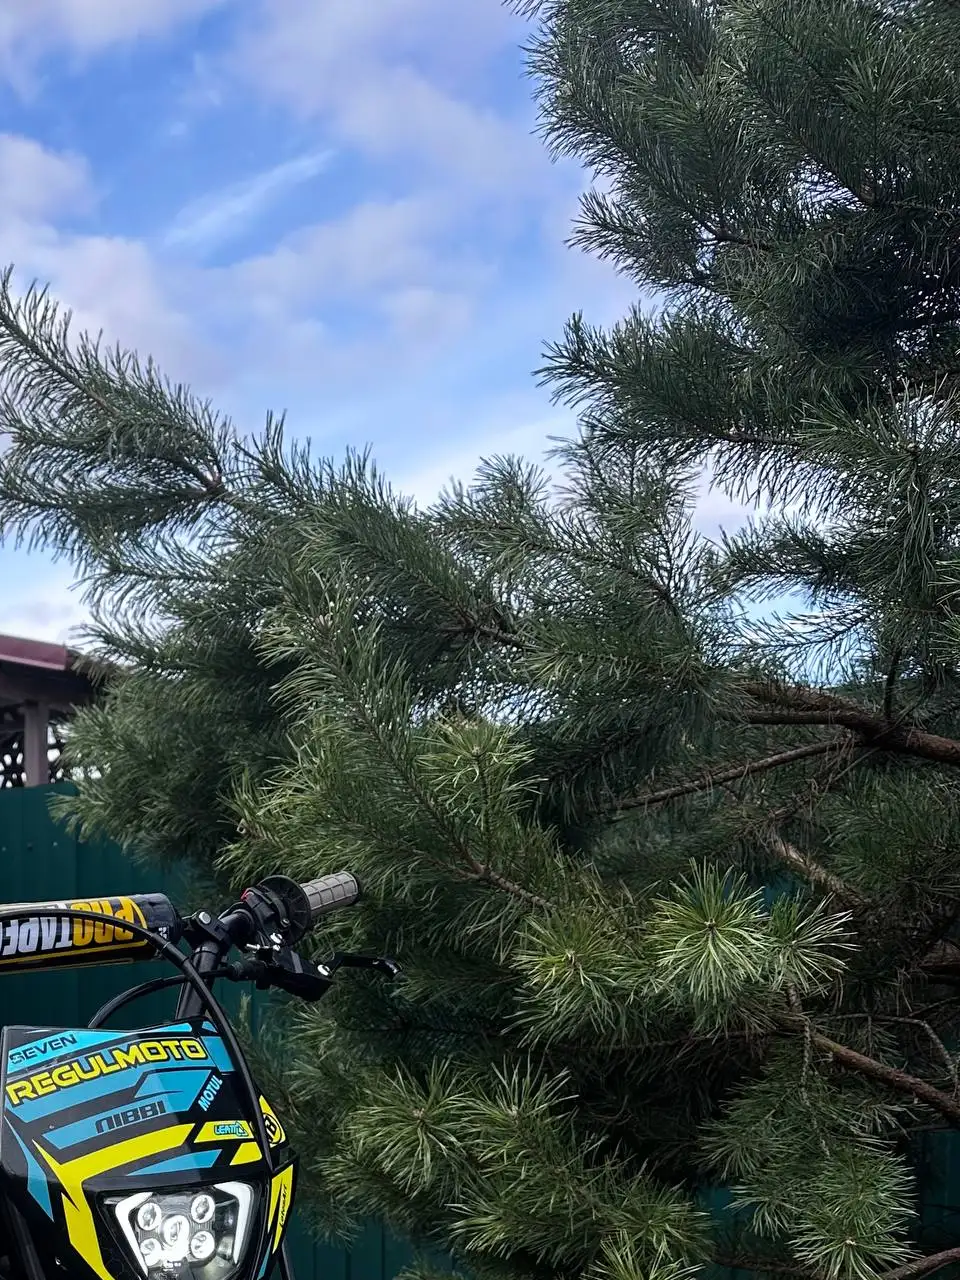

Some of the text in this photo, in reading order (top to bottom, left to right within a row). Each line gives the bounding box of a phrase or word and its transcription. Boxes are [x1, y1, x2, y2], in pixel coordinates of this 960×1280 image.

[9, 1034, 78, 1065] SEVEN
[5, 1039, 208, 1106] REGULMOTO
[197, 1075, 223, 1112] MOTUL
